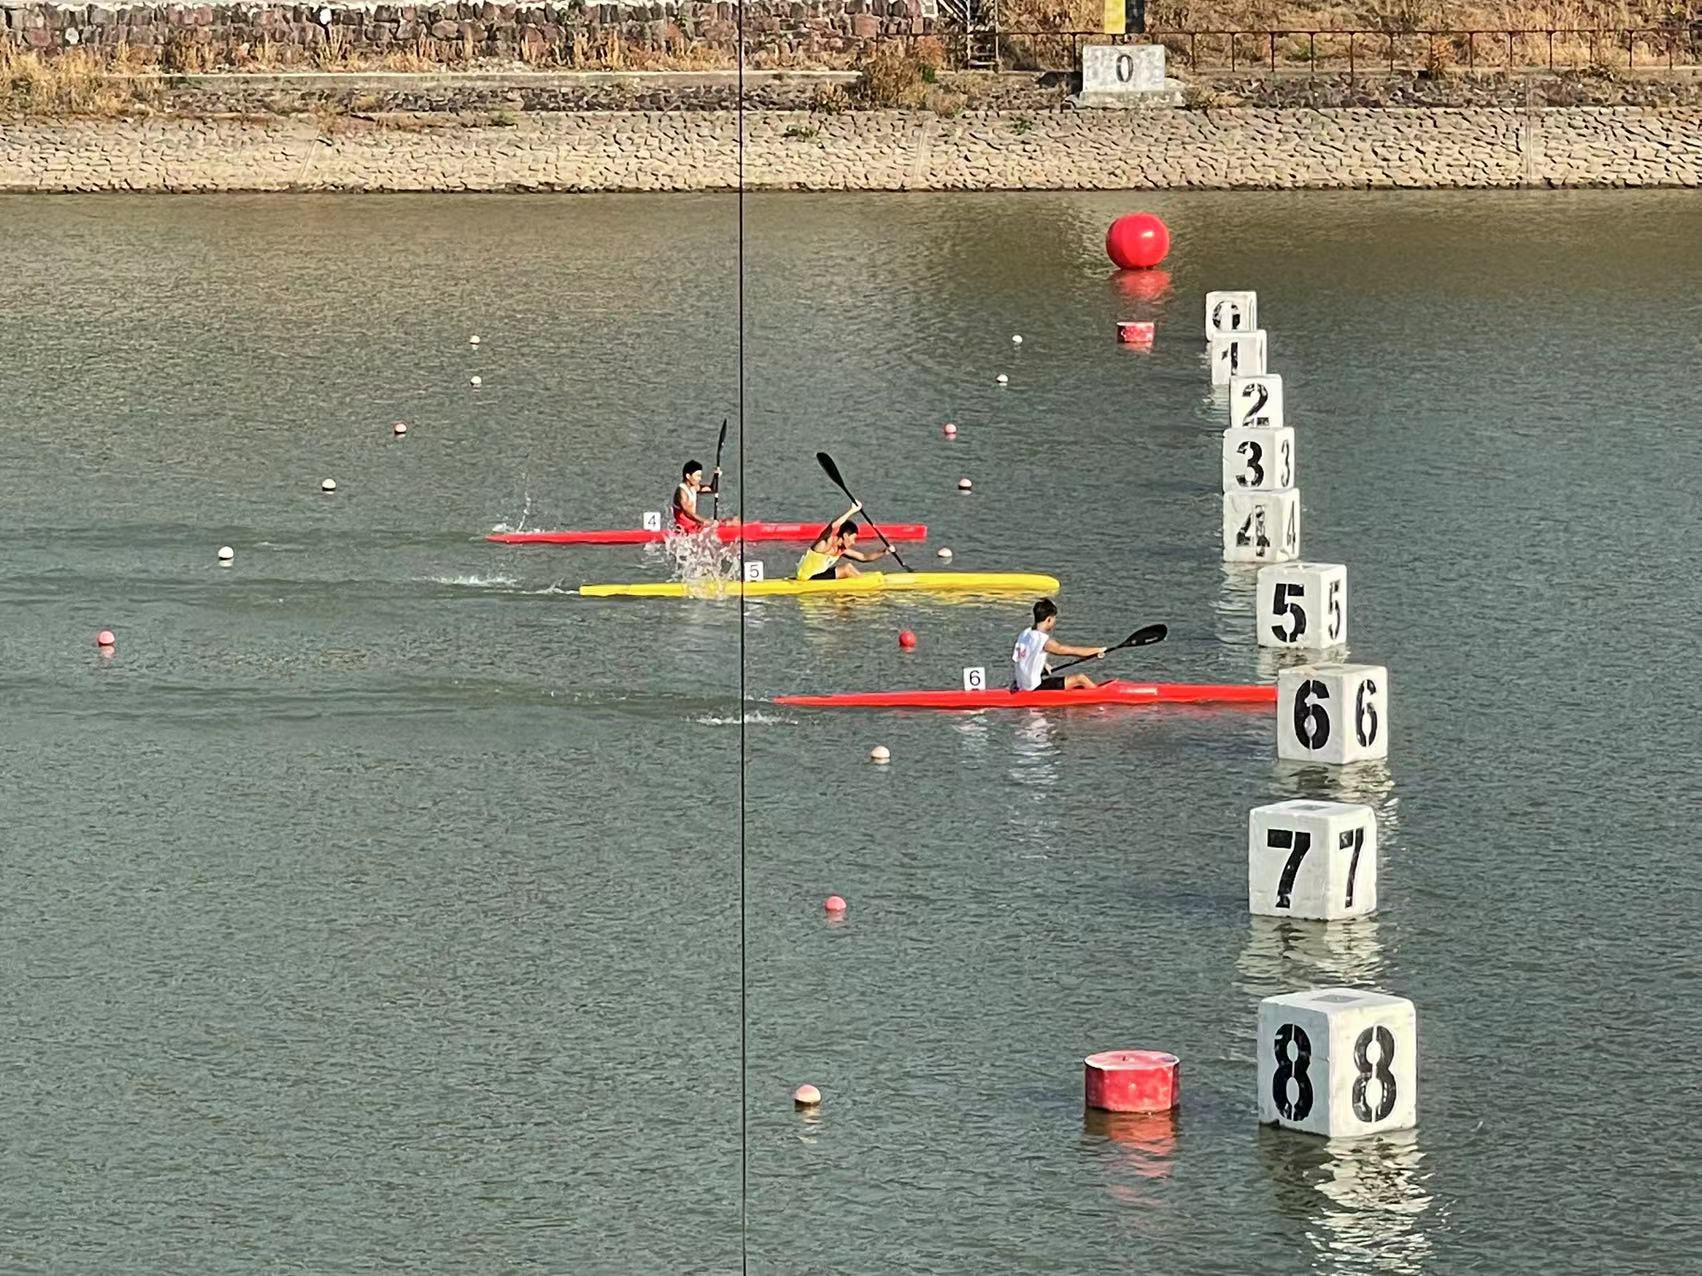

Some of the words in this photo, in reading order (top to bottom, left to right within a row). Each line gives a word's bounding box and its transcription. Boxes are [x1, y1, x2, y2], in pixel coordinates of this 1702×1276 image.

[1116, 54, 1133, 83] 0
[1221, 342, 1239, 376] 1
[1242, 383, 1270, 427] 2
[1235, 441, 1265, 488] 3
[1281, 439, 1291, 488] 3
[647, 514, 657, 528] 4
[1235, 504, 1271, 557] 4
[1286, 500, 1296, 555] 4
[749, 564, 760, 579] 5
[1271, 583, 1307, 643] 5
[1328, 580, 1341, 641] 5
[969, 670, 981, 686] 6
[1294, 679, 1331, 750] 6
[1355, 679, 1378, 748] 6
[1267, 828, 1311, 909] 7
[1339, 827, 1364, 909] 7
[1272, 1023, 1314, 1122] 8
[1352, 1025, 1397, 1123] 8
